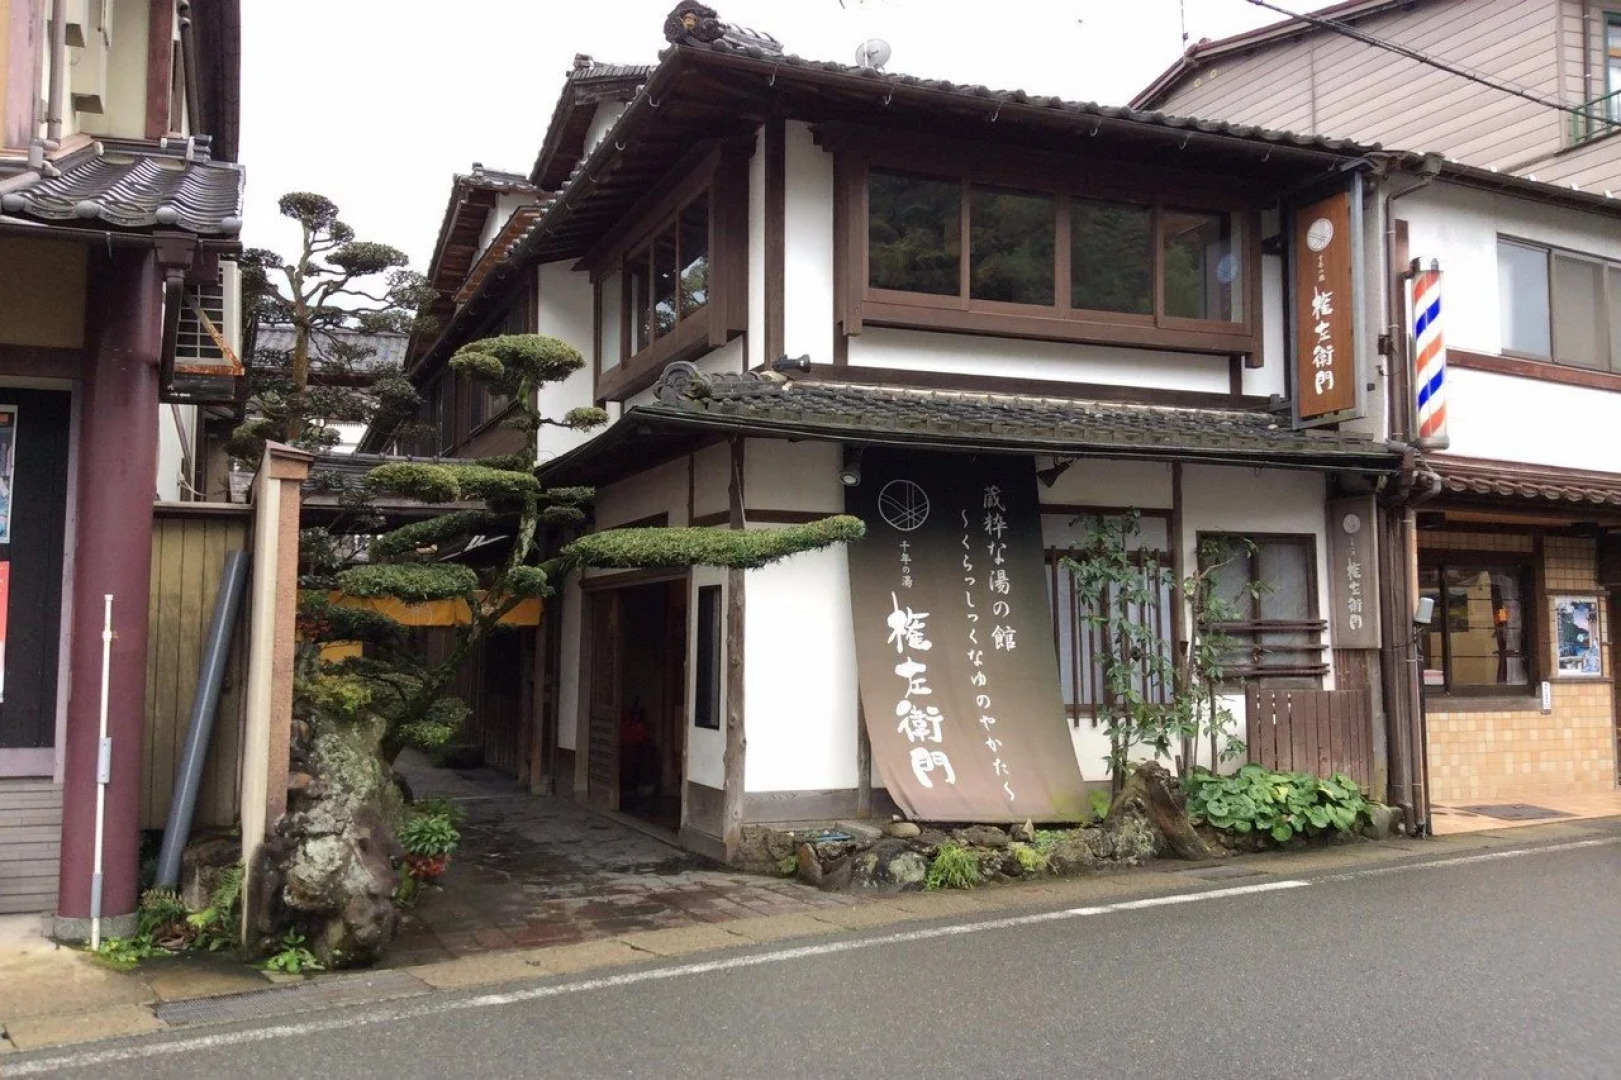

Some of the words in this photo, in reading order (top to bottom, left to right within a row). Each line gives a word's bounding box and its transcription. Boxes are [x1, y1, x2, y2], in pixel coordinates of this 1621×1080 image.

[1312, 286, 1334, 395] 権左衛門
[899, 540, 913, 588] 千年の湯
[982, 485, 1017, 651] 蔵粋な湯の館
[1346, 557, 1363, 630] 権左衛門
[887, 591, 956, 788] 権左衛門
